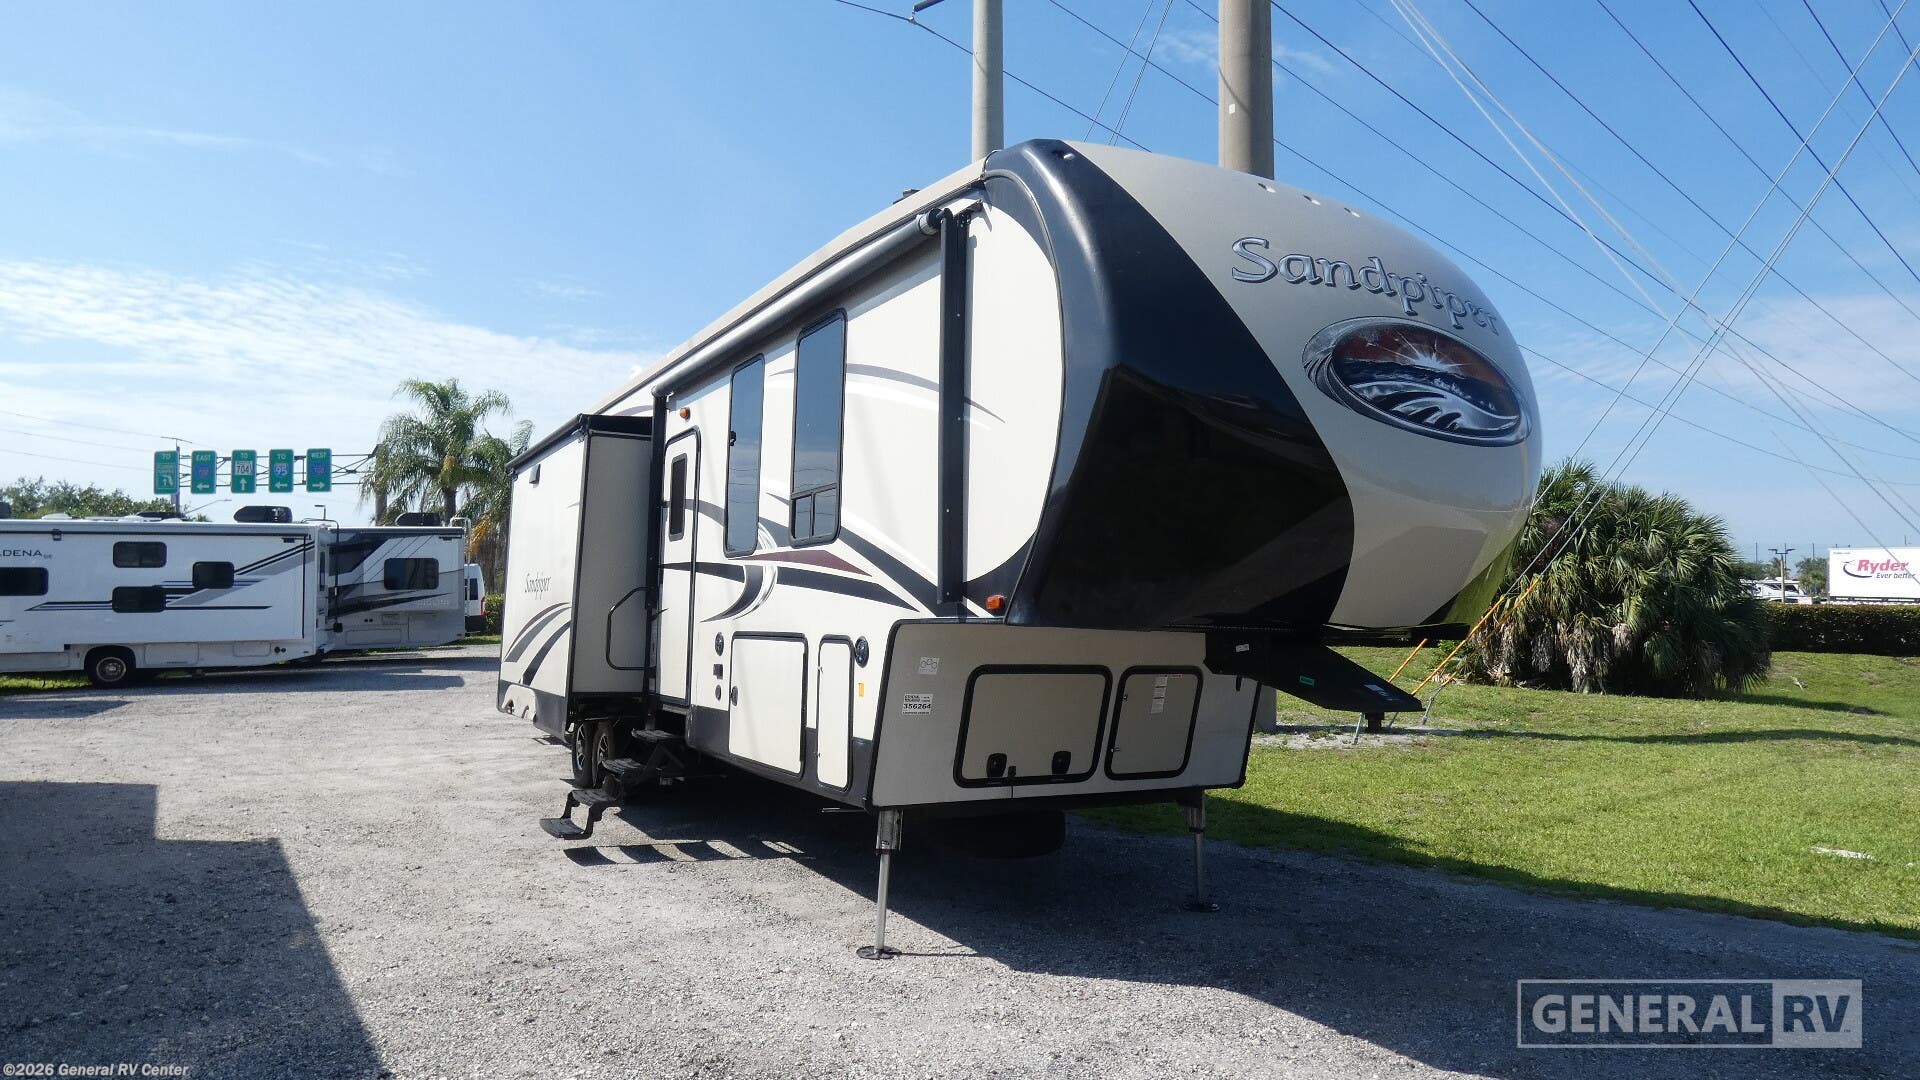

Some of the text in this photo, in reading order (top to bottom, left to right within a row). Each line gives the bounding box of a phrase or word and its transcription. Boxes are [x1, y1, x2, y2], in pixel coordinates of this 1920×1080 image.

[1231, 236, 1499, 336] Sandpiper
[195, 454, 211, 462] EAST
[275, 466, 288, 476] 95
[0, 549, 43, 557] DENA
[1857, 559, 1909, 574] Ryder
